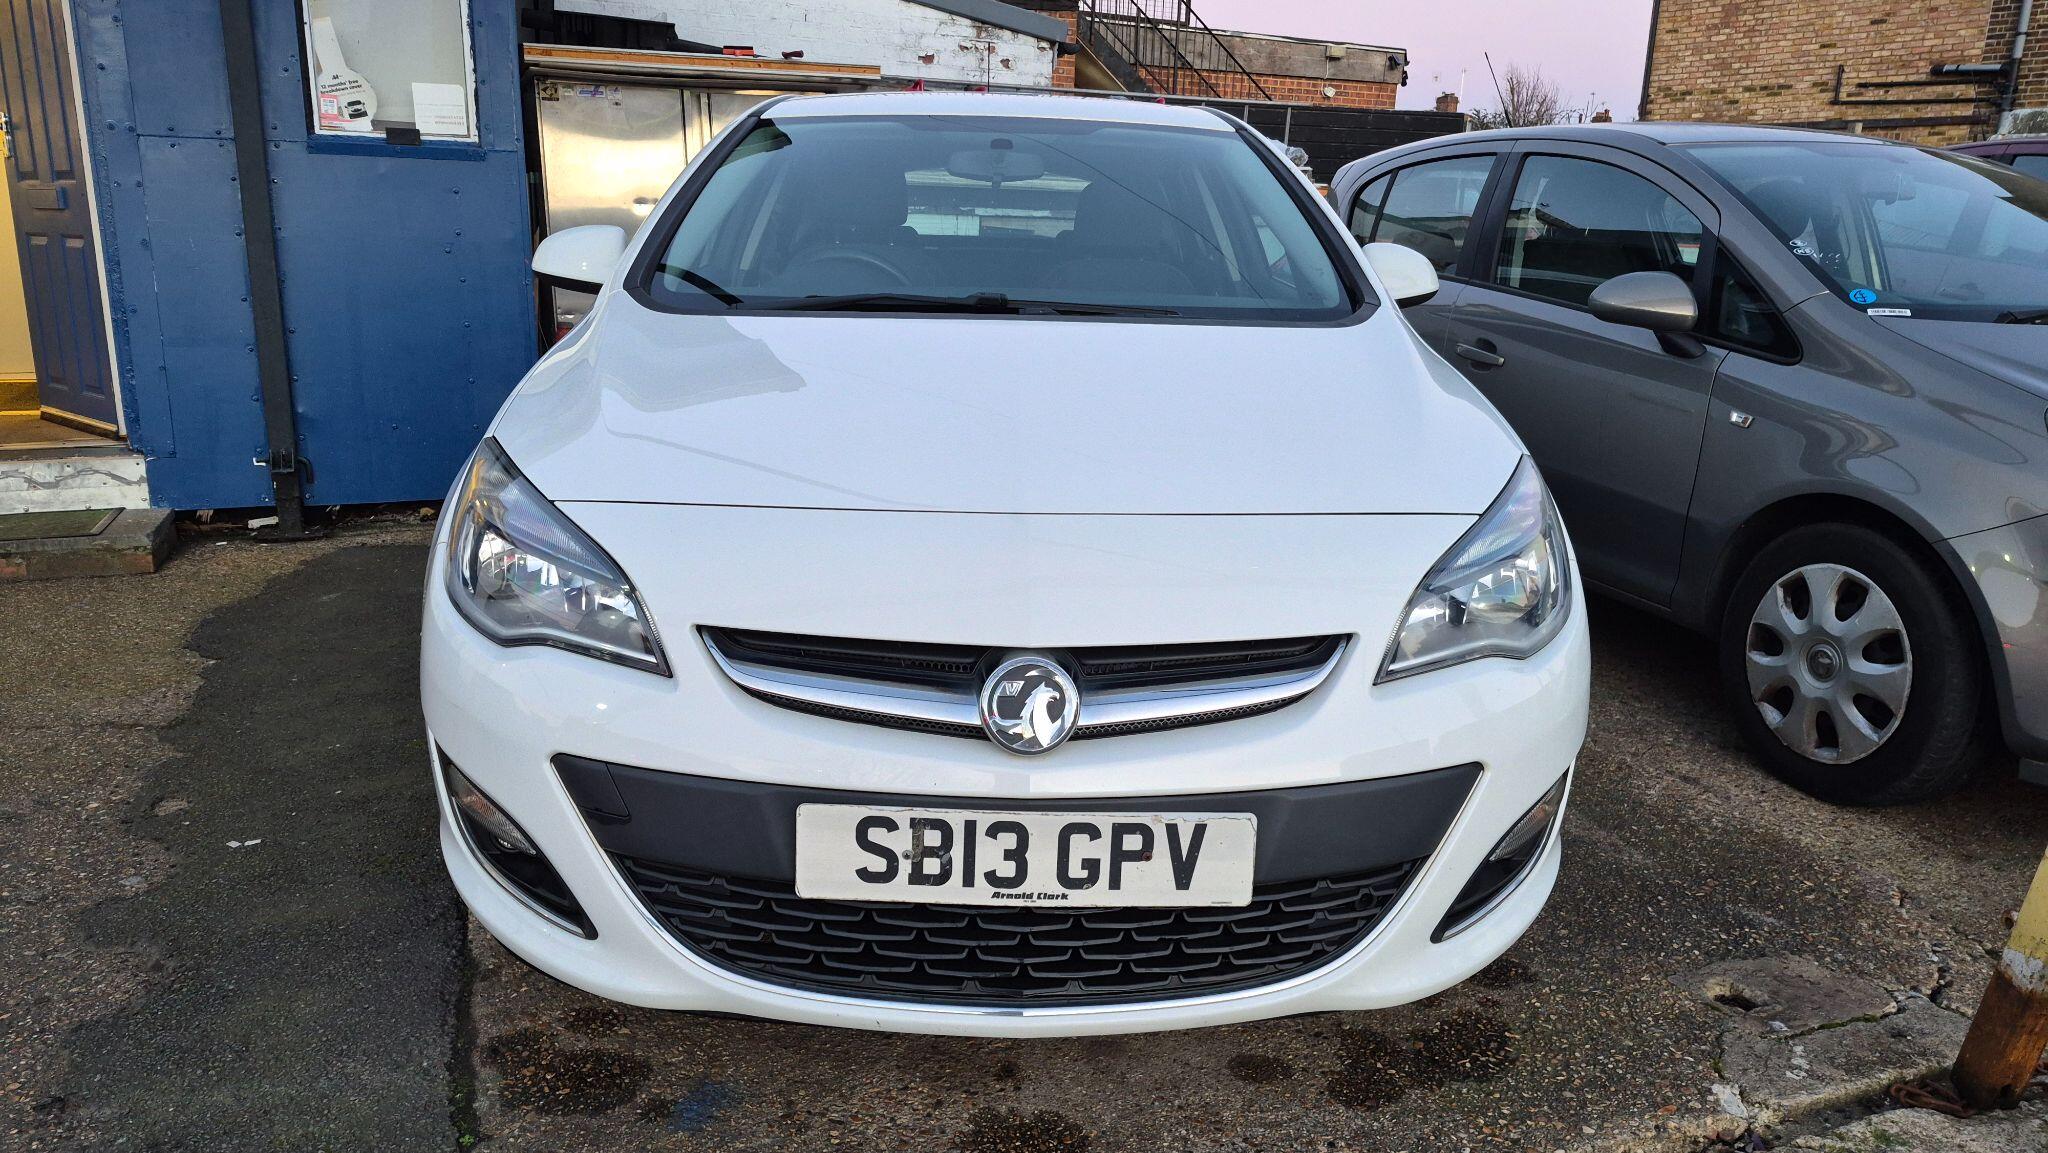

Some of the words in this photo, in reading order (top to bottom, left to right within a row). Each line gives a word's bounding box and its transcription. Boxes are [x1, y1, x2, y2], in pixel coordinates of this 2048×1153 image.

[320, 86, 348, 94] breakdown
[855, 815, 1030, 888] SB13
[1056, 822, 1208, 891] GPV
[991, 891, 1035, 900] Arnold
[1036, 892, 1069, 900] Clark
